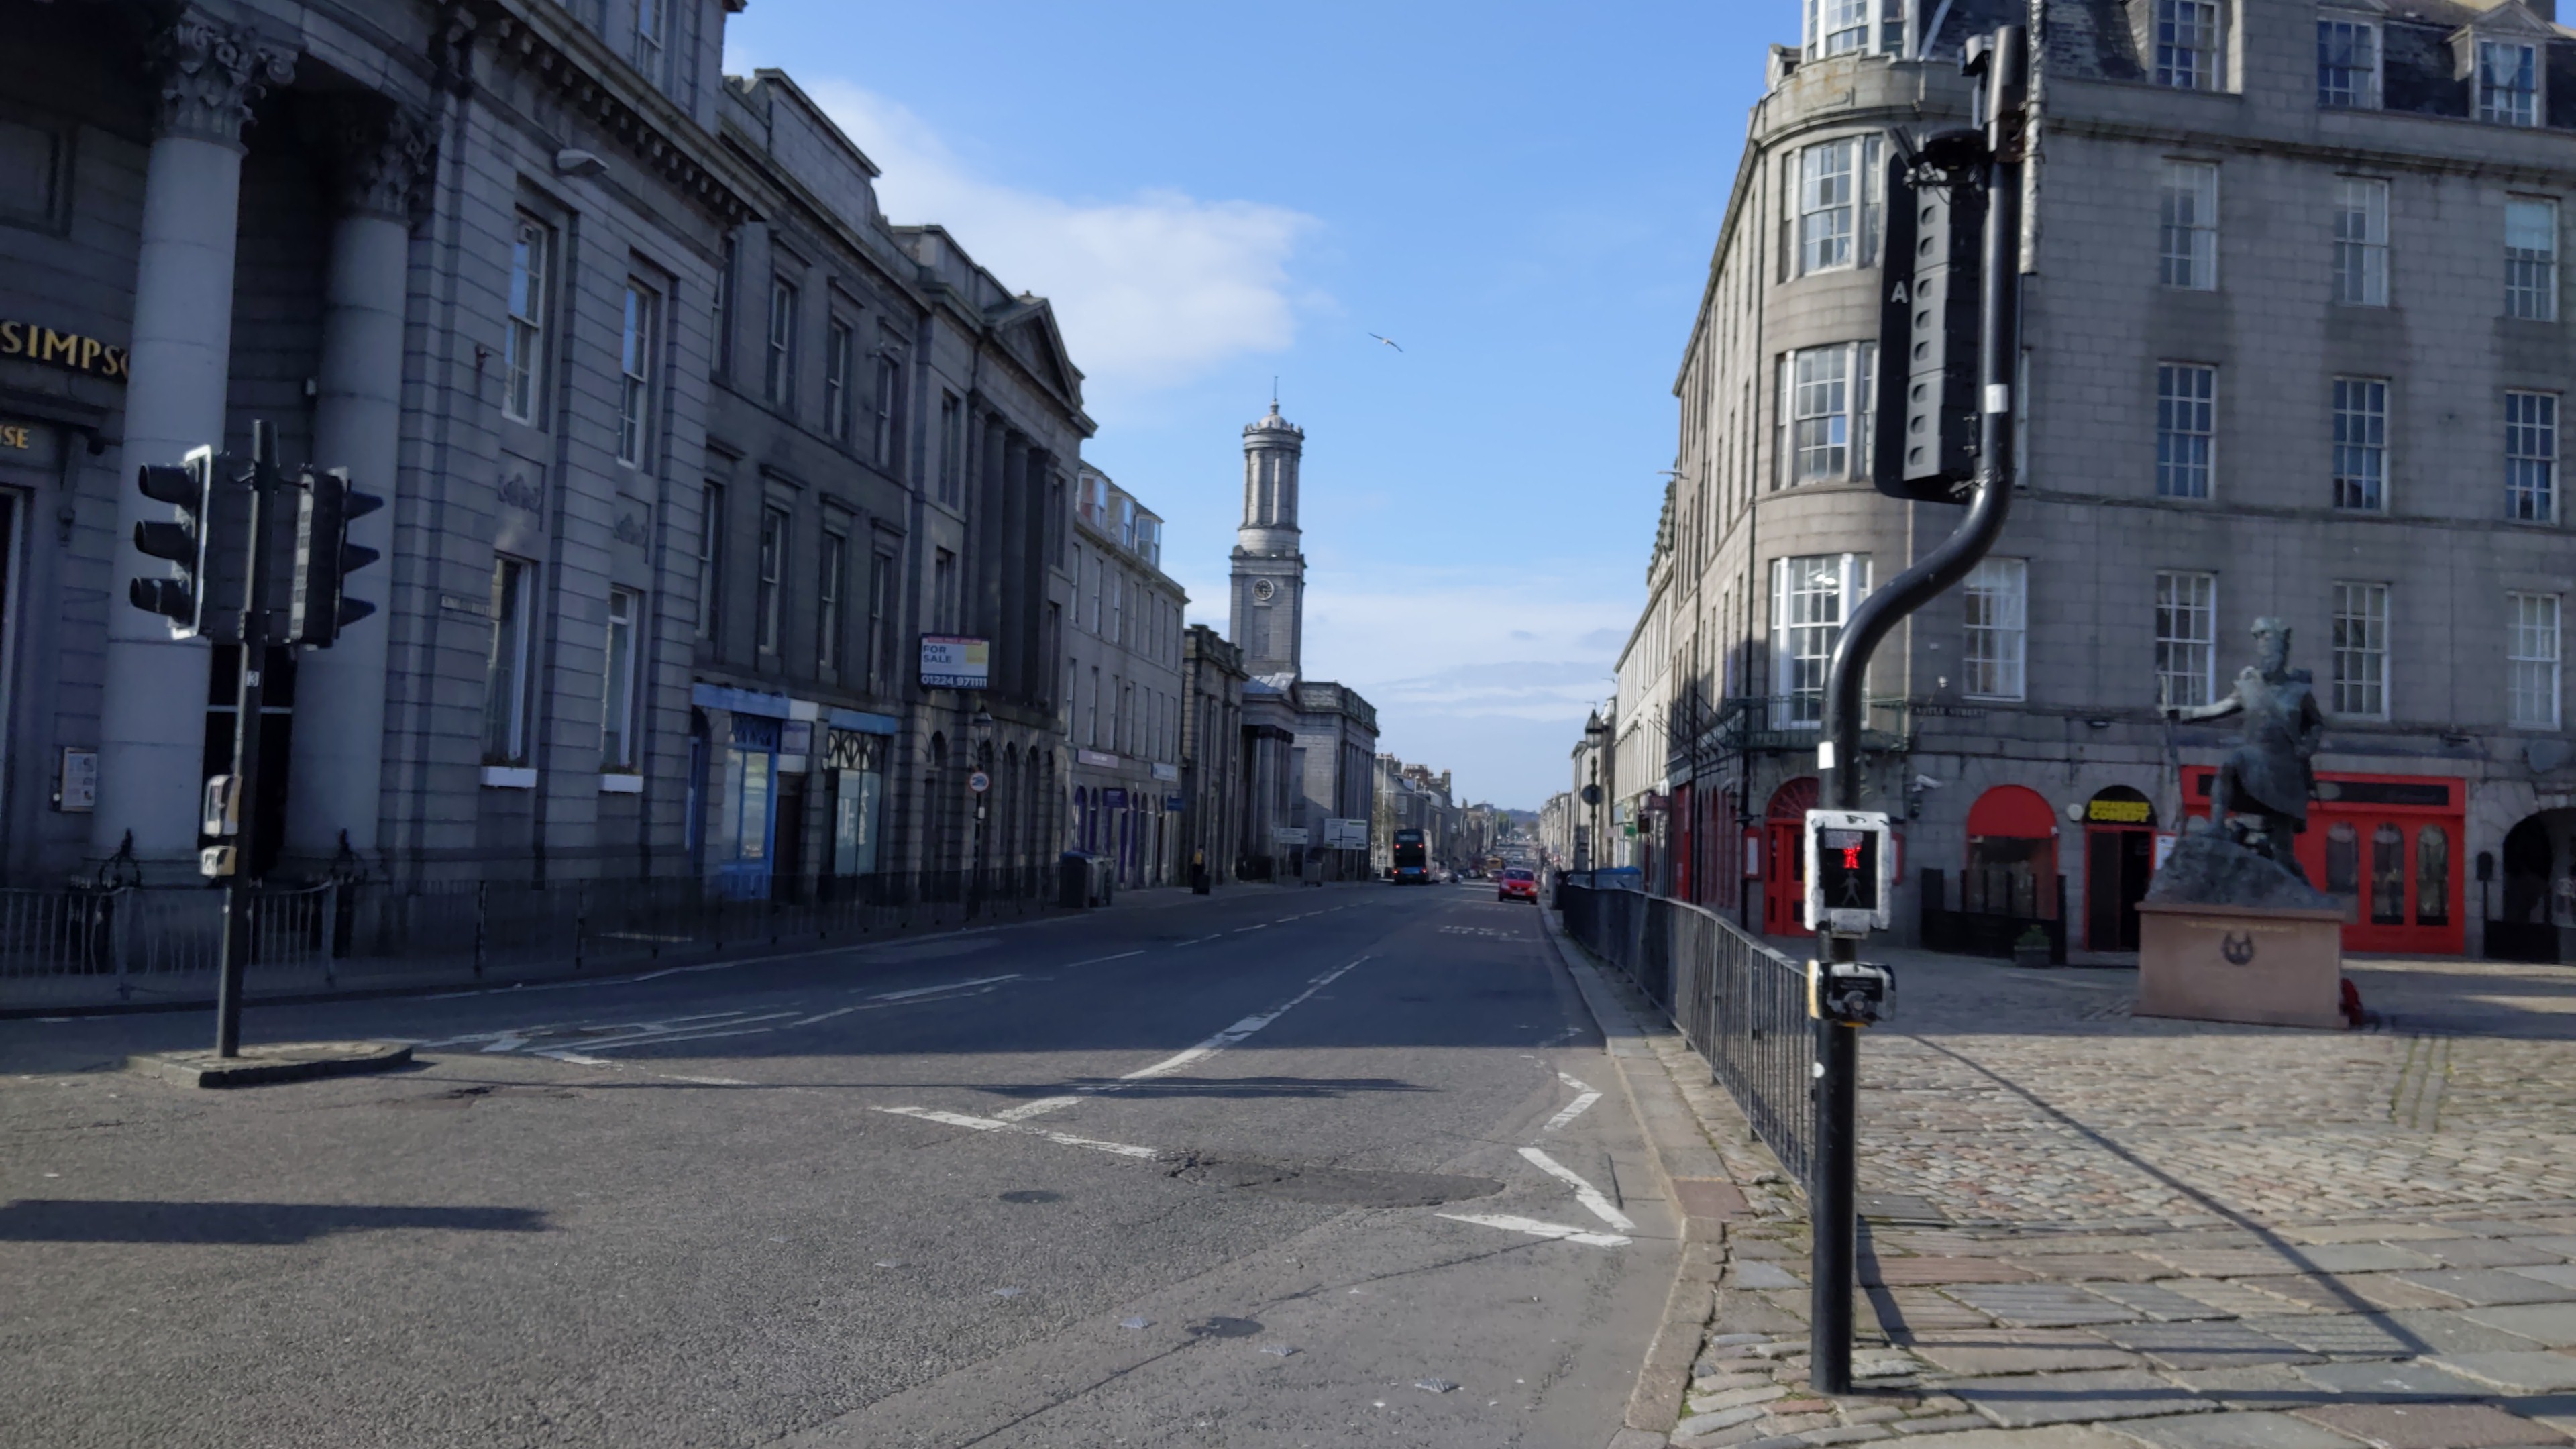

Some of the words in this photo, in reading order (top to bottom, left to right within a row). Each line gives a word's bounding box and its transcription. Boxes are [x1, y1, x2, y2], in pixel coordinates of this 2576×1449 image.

[1890, 280, 1908, 303] A
[0, 425, 30, 449] SE
[923, 645, 947, 653] FOR
[923, 655, 952, 663] SALE
[921, 675, 953, 685] 01224
[957, 676, 987, 688] 971111
